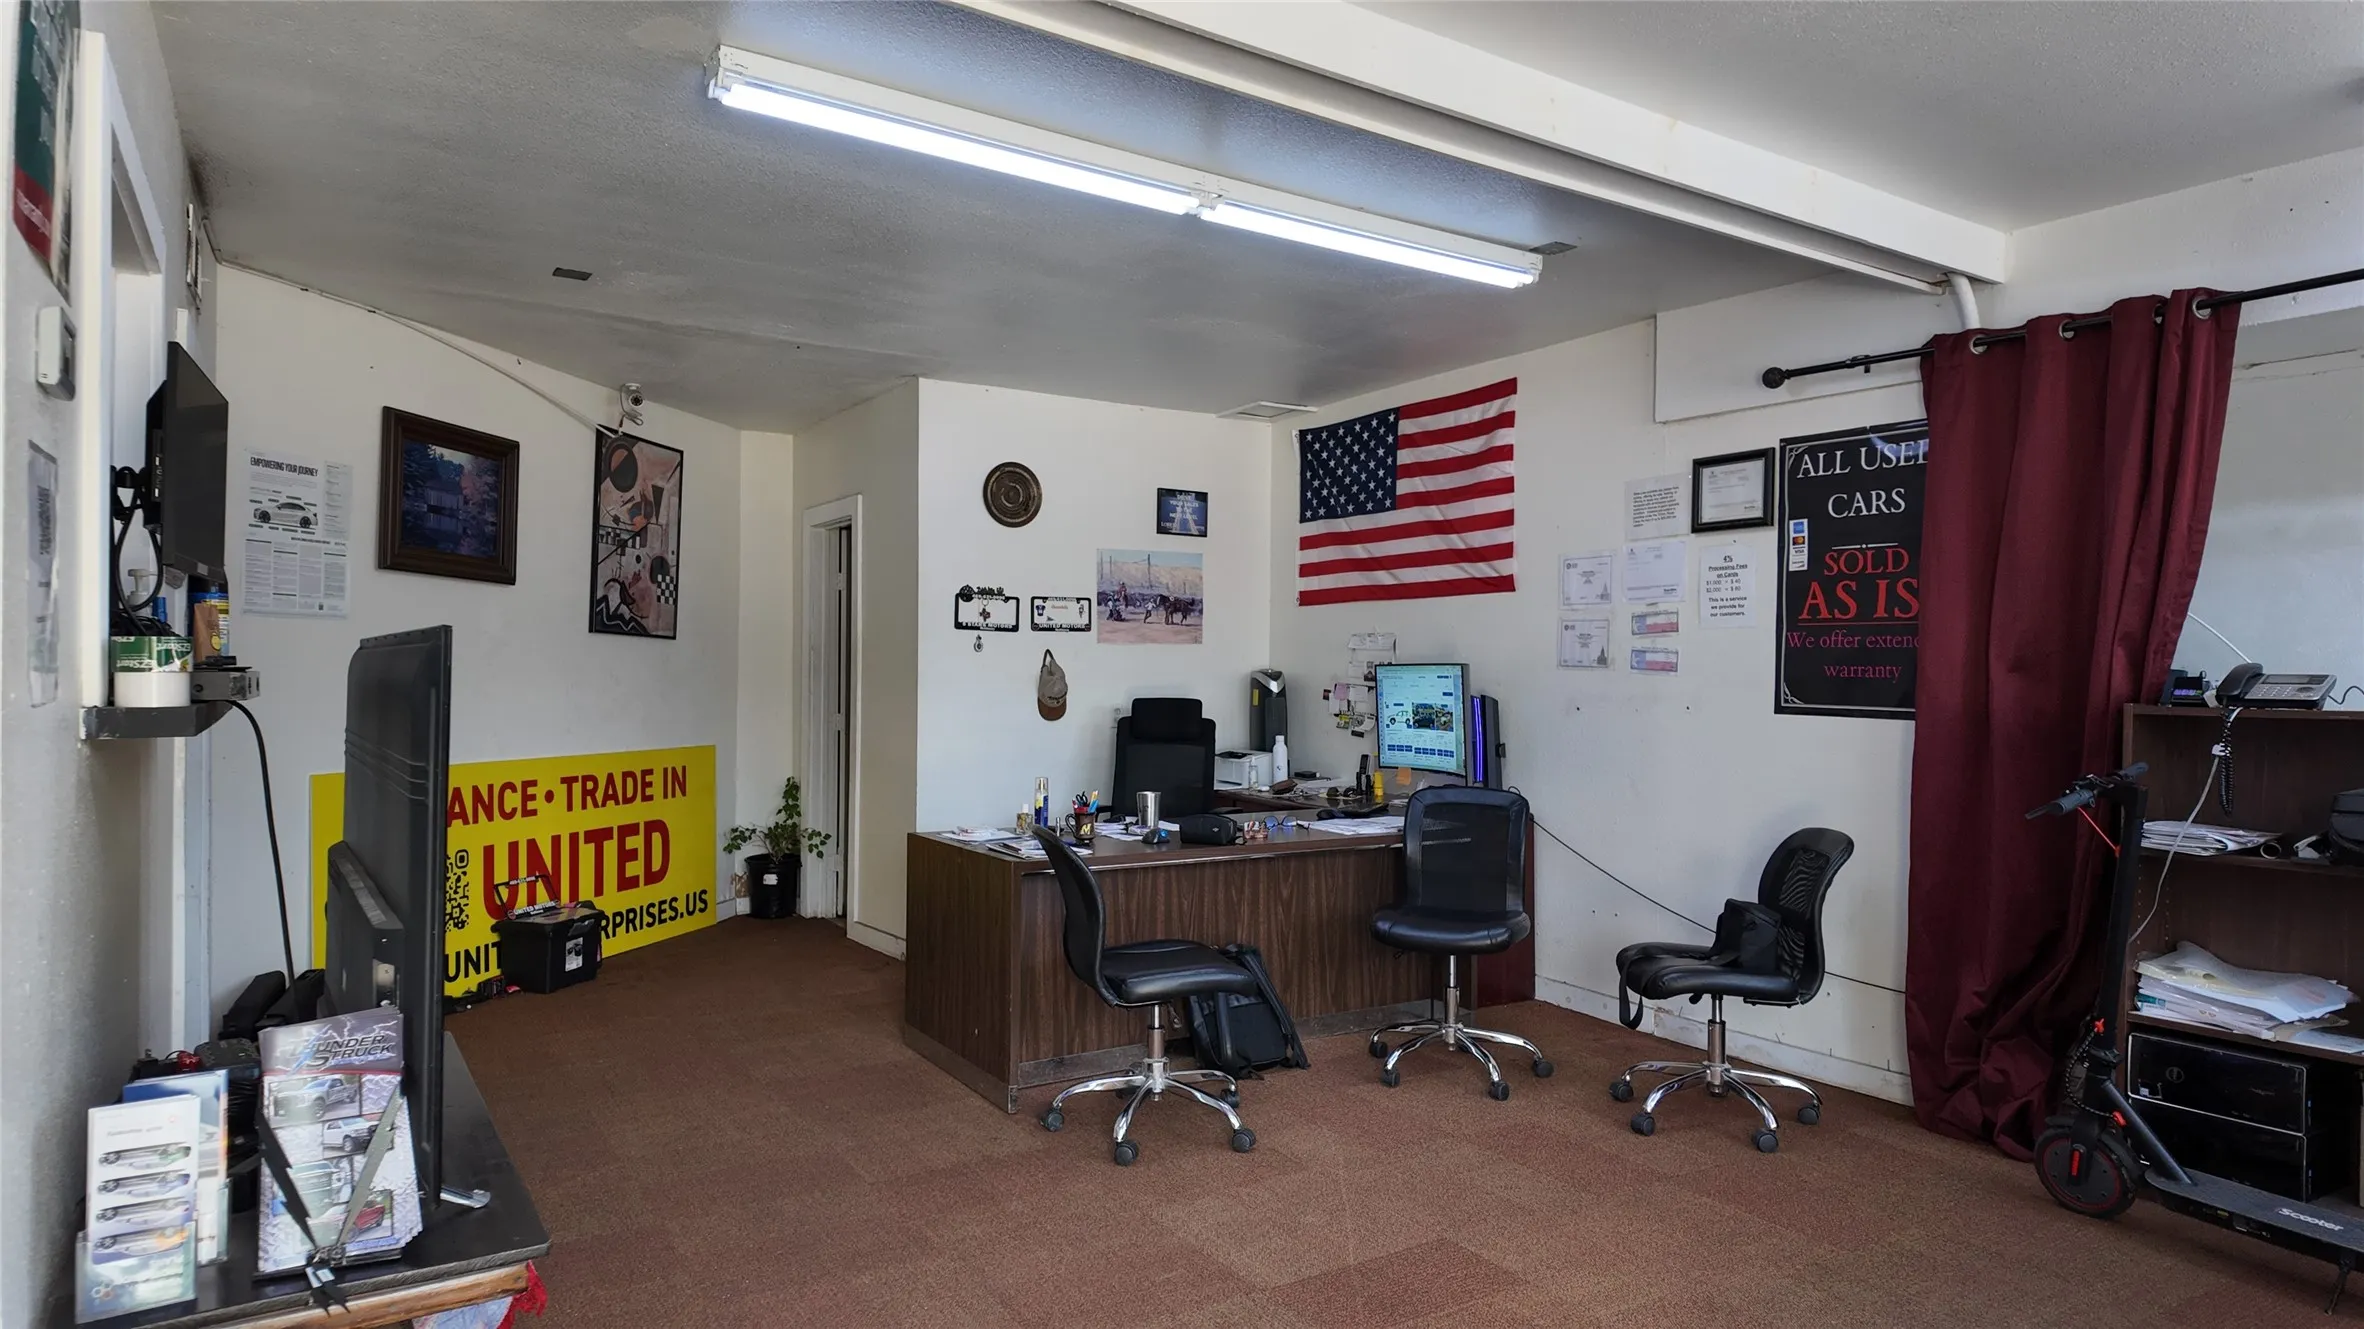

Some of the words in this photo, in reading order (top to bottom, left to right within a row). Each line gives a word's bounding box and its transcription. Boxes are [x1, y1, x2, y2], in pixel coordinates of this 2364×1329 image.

[250, 456, 285, 472] EMPOWERING
[285, 463, 298, 474] YOUR
[297, 465, 319, 477] JOURNEY
[1797, 450, 1851, 478] ALL
[1828, 488, 1906, 518] CARS
[1824, 548, 1910, 576] SOLD
[1798, 580, 1858, 619] AS
[1873, 577, 1920, 618] IS
[1787, 632, 1815, 649] We
[1820, 629, 1861, 648] offer
[1824, 665, 1902, 684] warranty
[560, 768, 654, 813] TRADE
[663, 765, 687, 799] IN
[484, 819, 670, 921] UNITED
[306, 1041, 394, 1068] STRUCK
[2279, 1208, 2344, 1231] Scooter
